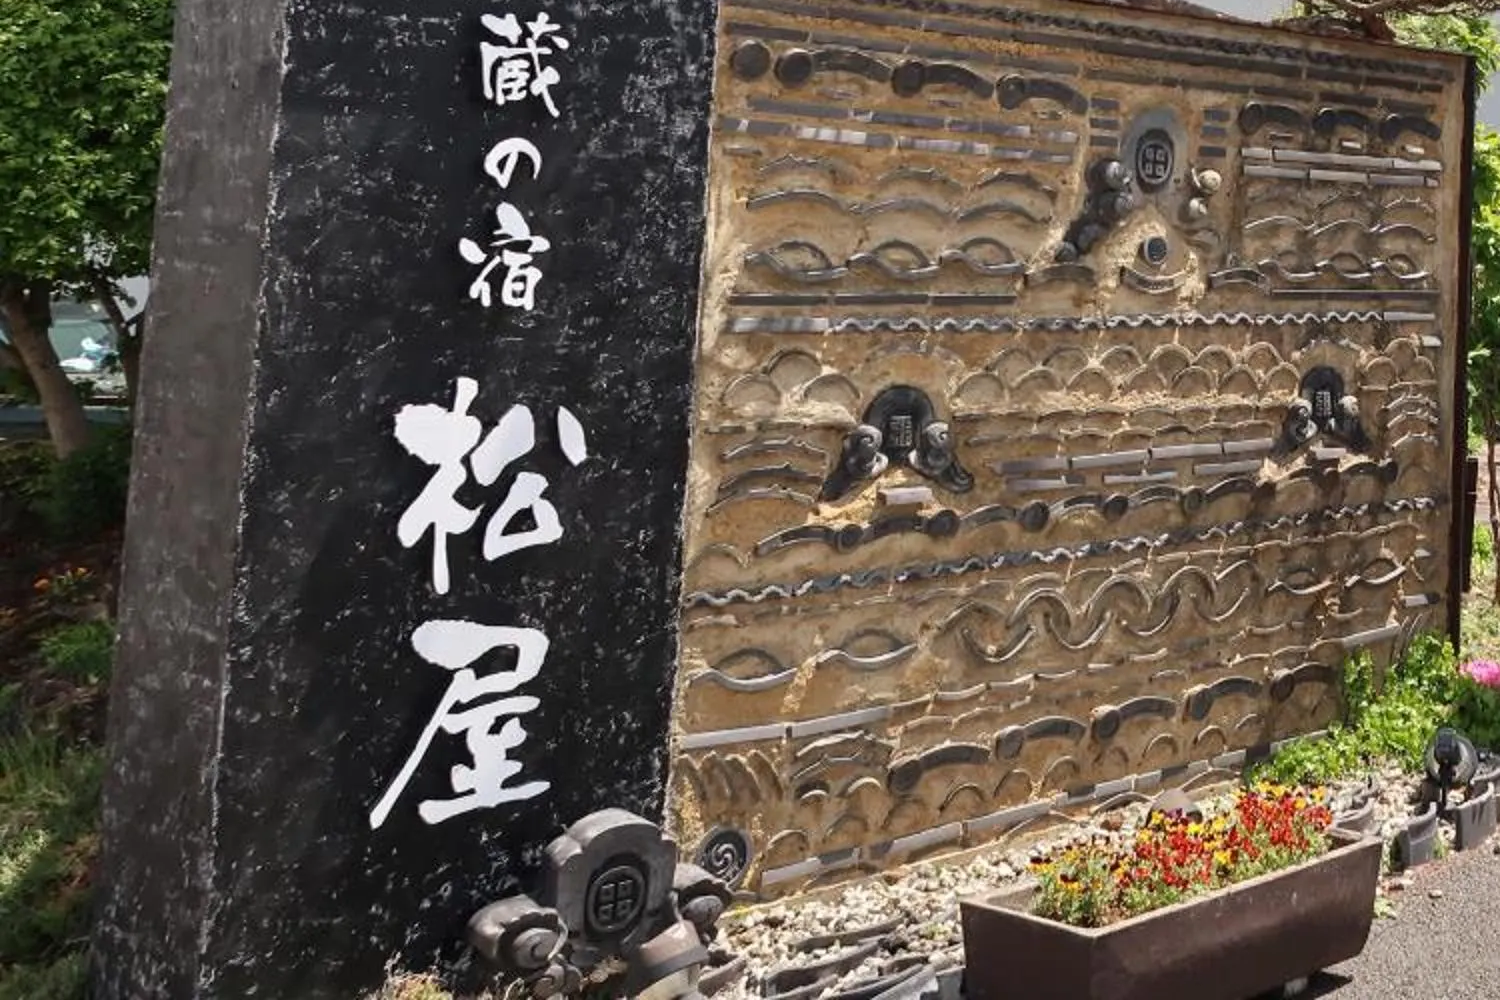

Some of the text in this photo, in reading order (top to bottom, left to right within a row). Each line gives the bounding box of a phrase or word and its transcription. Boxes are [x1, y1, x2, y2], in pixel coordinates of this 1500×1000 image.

[369, 11, 588, 831] 蔵の宿 松屋
